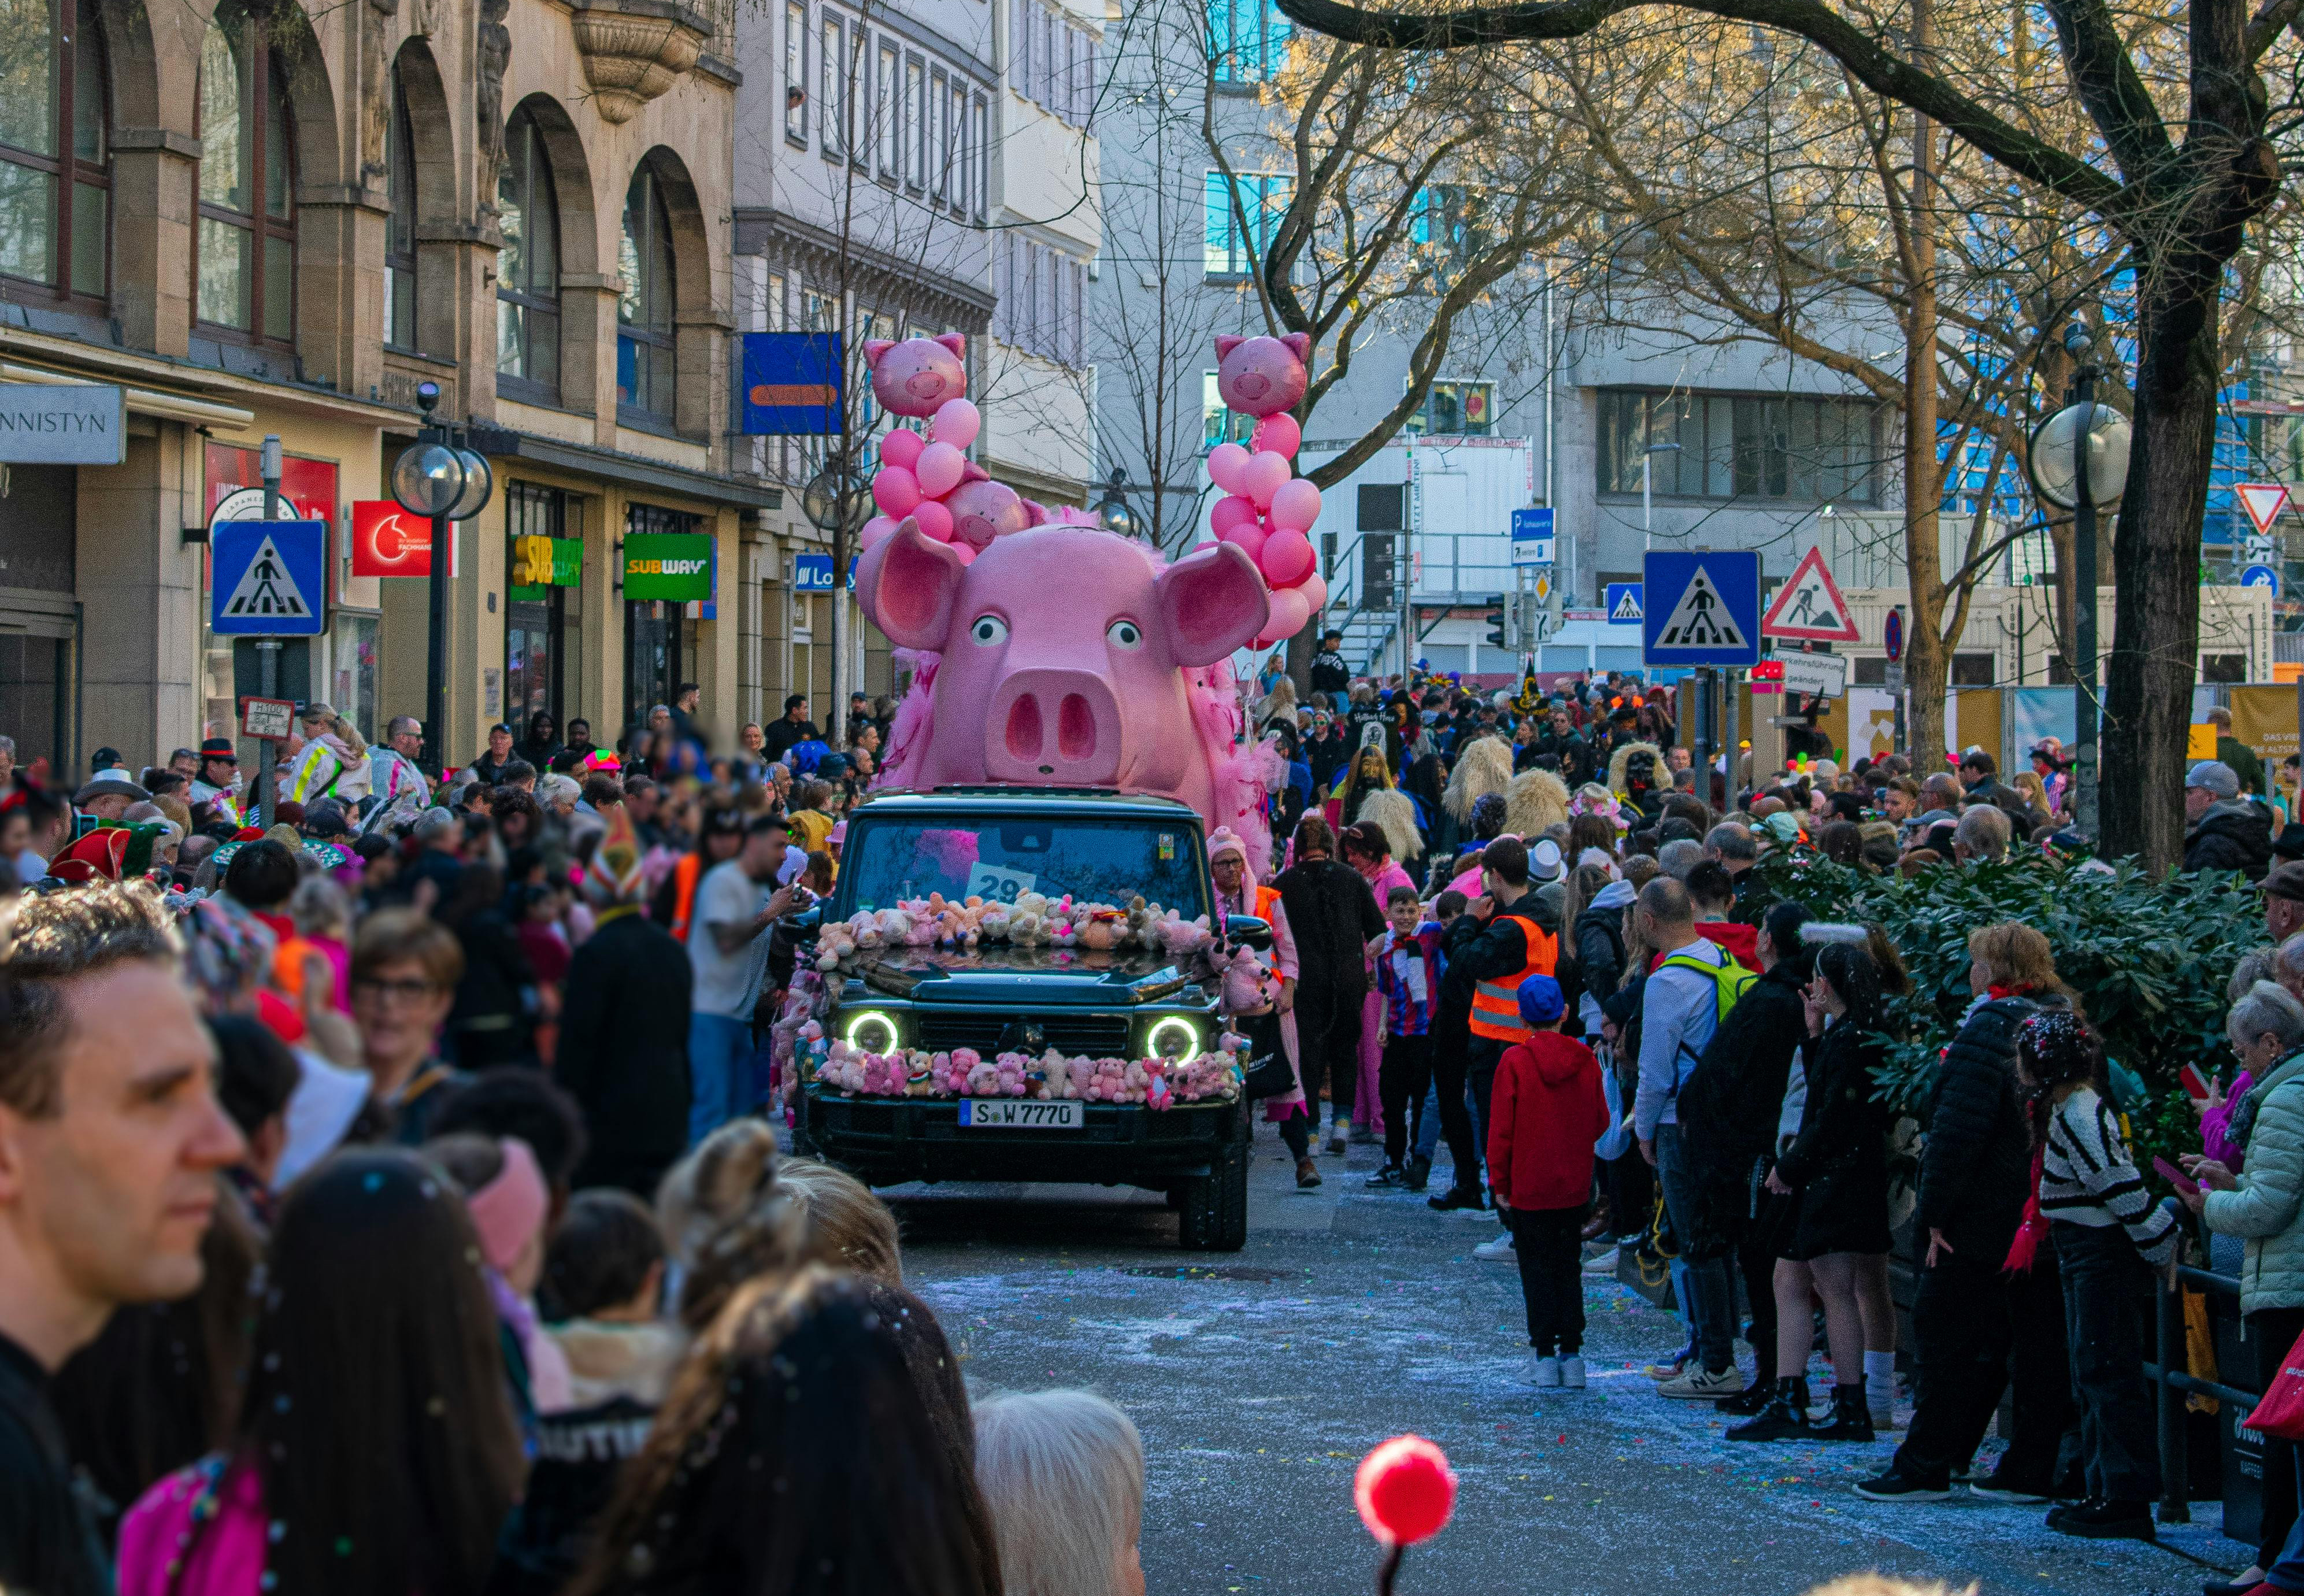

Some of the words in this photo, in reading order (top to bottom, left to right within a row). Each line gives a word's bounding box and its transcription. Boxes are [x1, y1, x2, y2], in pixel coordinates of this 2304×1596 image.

[0, 412, 105, 433] NNISTYN
[1467, 439, 1525, 448] ENGELHARDT
[225, 497, 264, 514] JAPANES
[626, 559, 707, 574] SUBWAY
[1775, 654, 1844, 673] Verkehrsführung
[2283, 733, 2299, 742] VIE
[2267, 745, 2300, 753] ALTSTA
[978, 875, 1020, 906] 29
[976, 1104, 989, 1123] S
[1003, 1104, 1016, 1123] W
[1021, 1105, 1071, 1124] 7770
